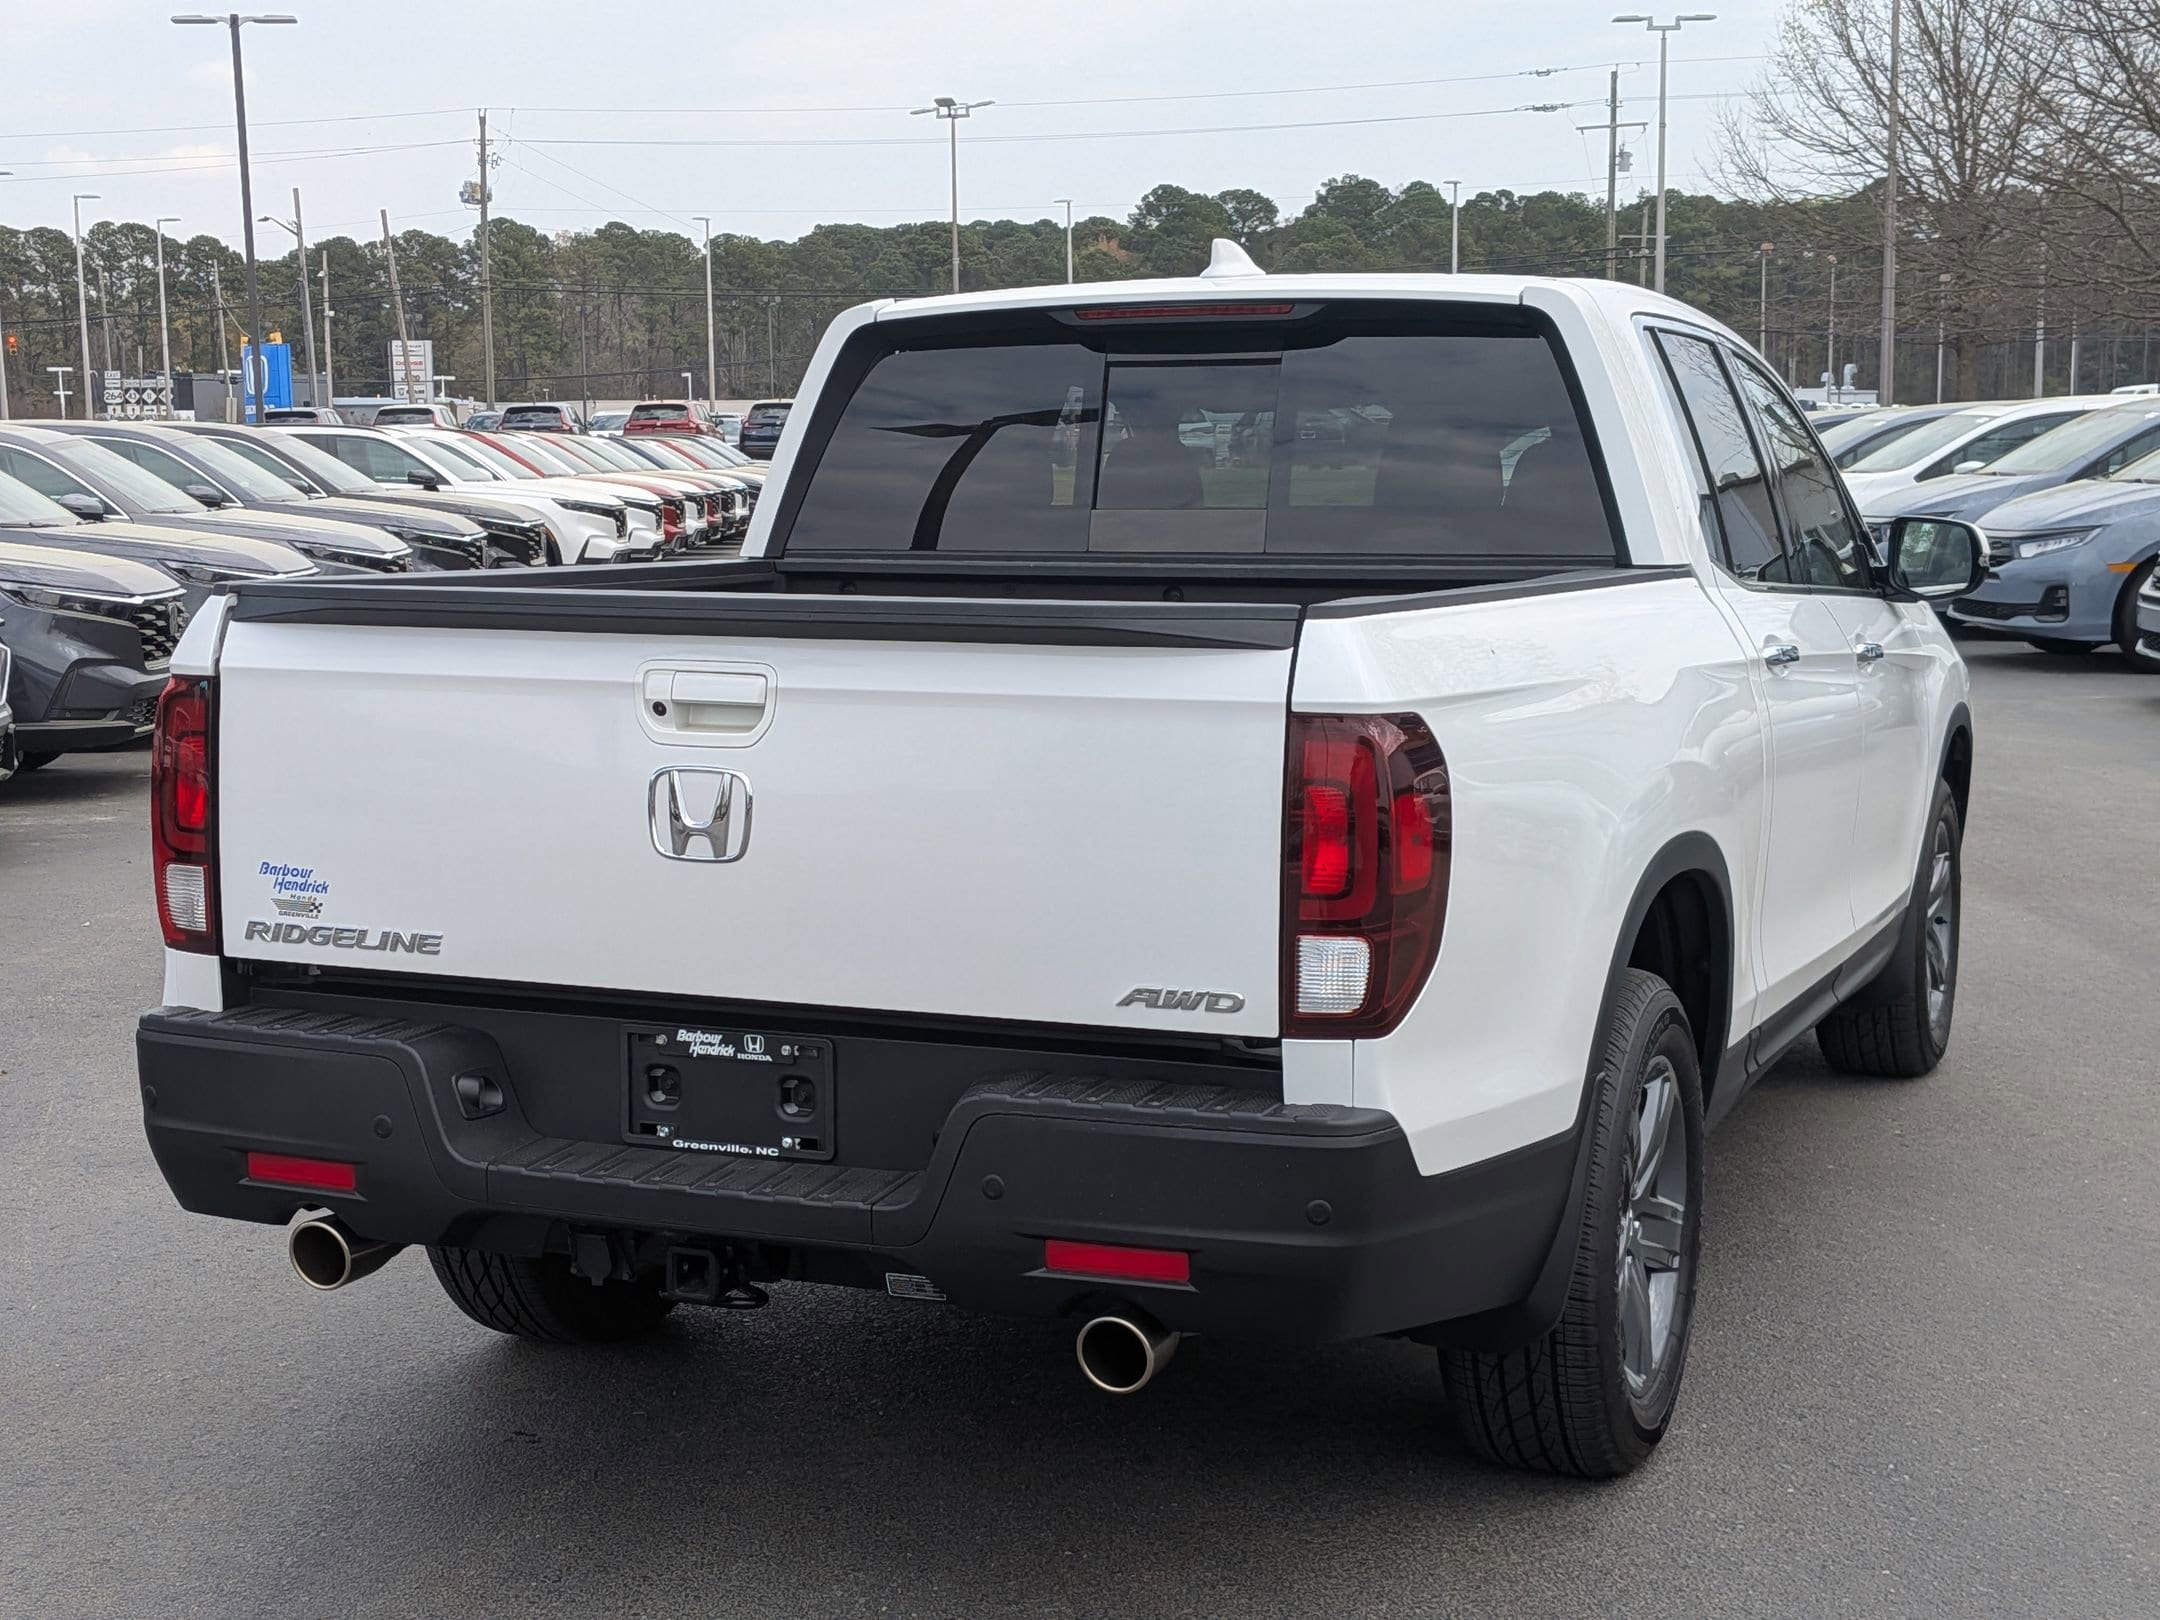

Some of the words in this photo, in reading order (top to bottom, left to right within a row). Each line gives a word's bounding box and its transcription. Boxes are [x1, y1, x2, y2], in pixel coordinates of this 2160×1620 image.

[105, 391, 122, 401] 264
[259, 861, 314, 879] Barbour
[273, 876, 329, 894] Hendrick
[278, 910, 319, 919] GREENVILLE
[244, 919, 444, 955] RIDGELINE
[1115, 986, 1246, 1014] AWD
[676, 1028, 723, 1044] Barbour
[688, 1040, 735, 1057] Hendrick
[737, 1052, 773, 1062] HONDA
[755, 1146, 780, 1157] NC
